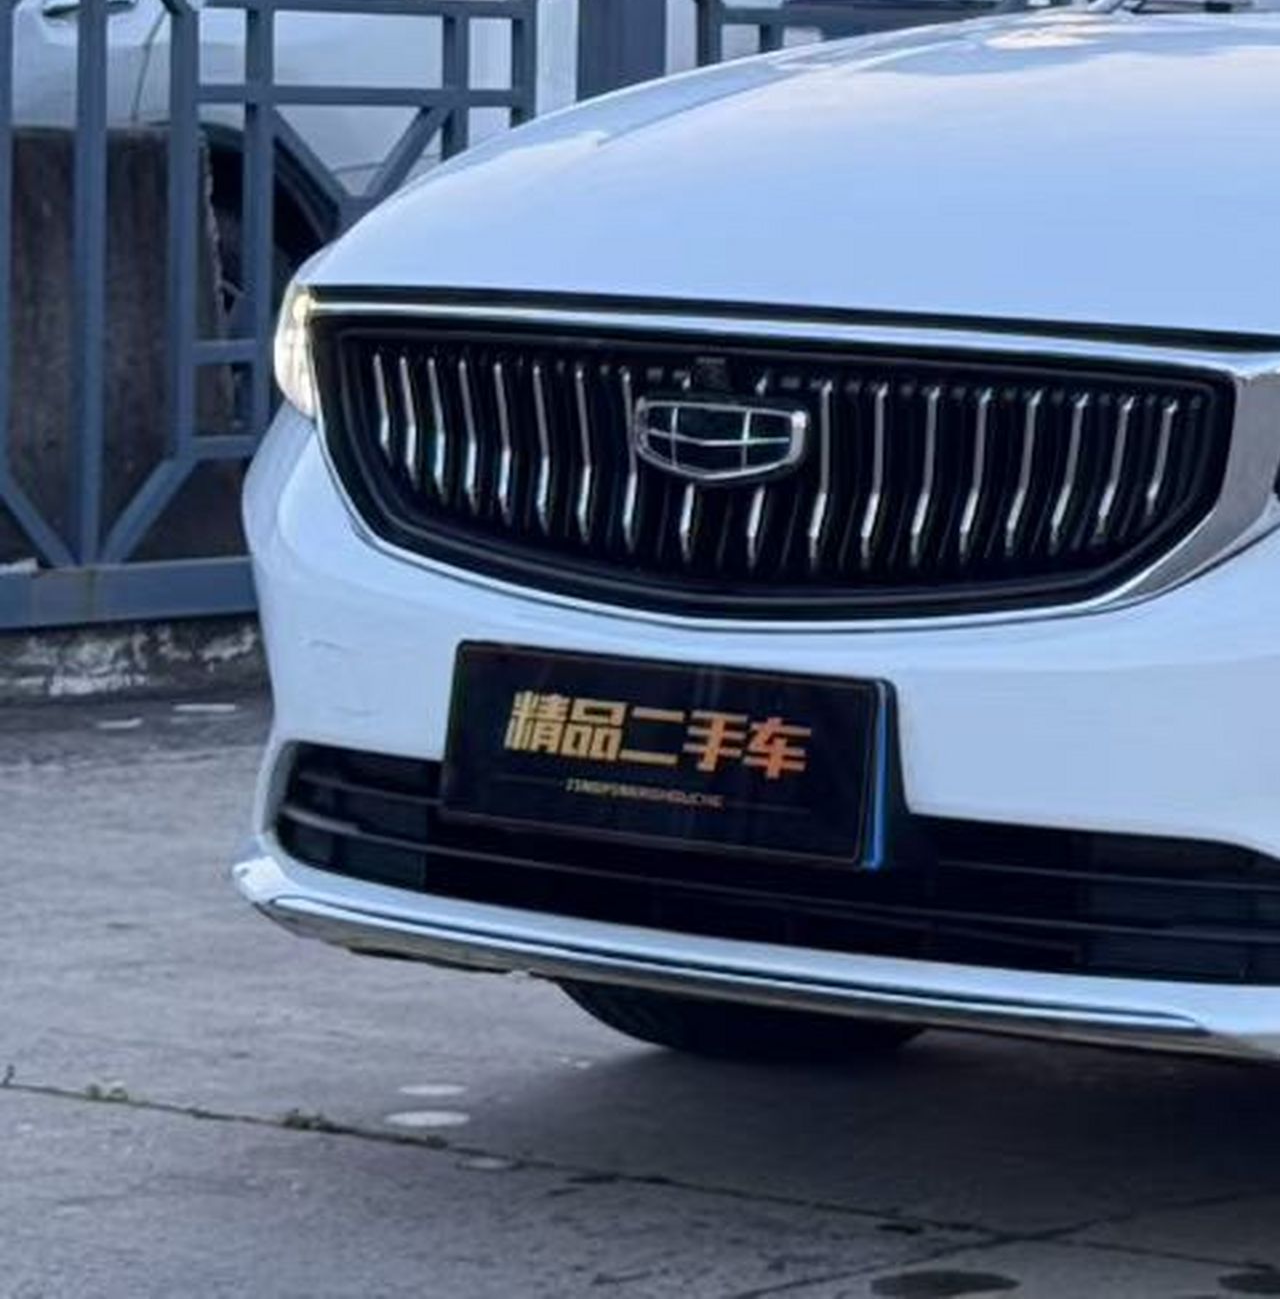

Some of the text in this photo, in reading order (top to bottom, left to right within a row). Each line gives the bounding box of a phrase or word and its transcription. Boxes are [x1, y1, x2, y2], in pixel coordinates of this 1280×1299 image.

[504, 690, 811, 779] 精品二手车
